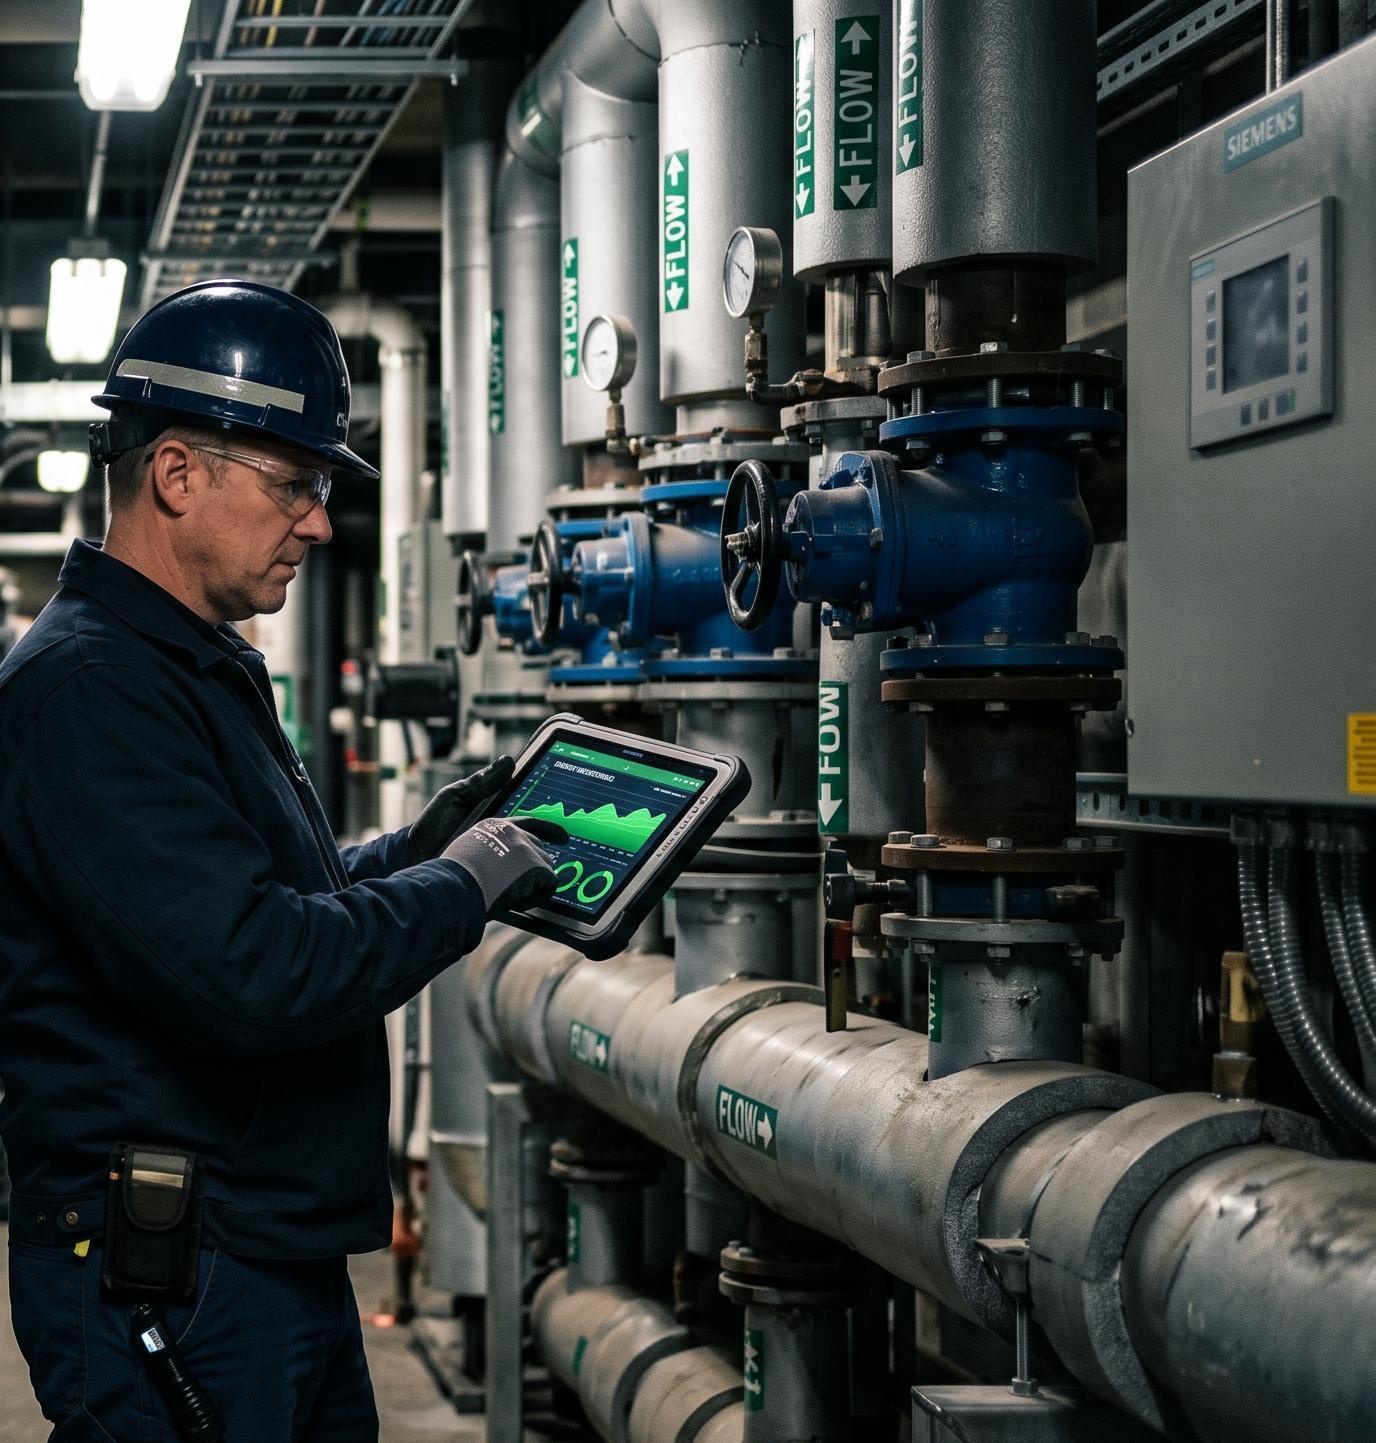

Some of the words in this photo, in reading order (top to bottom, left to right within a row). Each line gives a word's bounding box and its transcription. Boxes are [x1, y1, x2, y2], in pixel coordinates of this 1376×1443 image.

[795, 79, 812, 178] FLOW
[839, 69, 873, 167] FLOW
[1228, 105, 1297, 161] SIEMENS
[665, 195, 686, 280] FLOW
[563, 277, 577, 353] FLOW
[719, 1091, 758, 1147] FLOW
